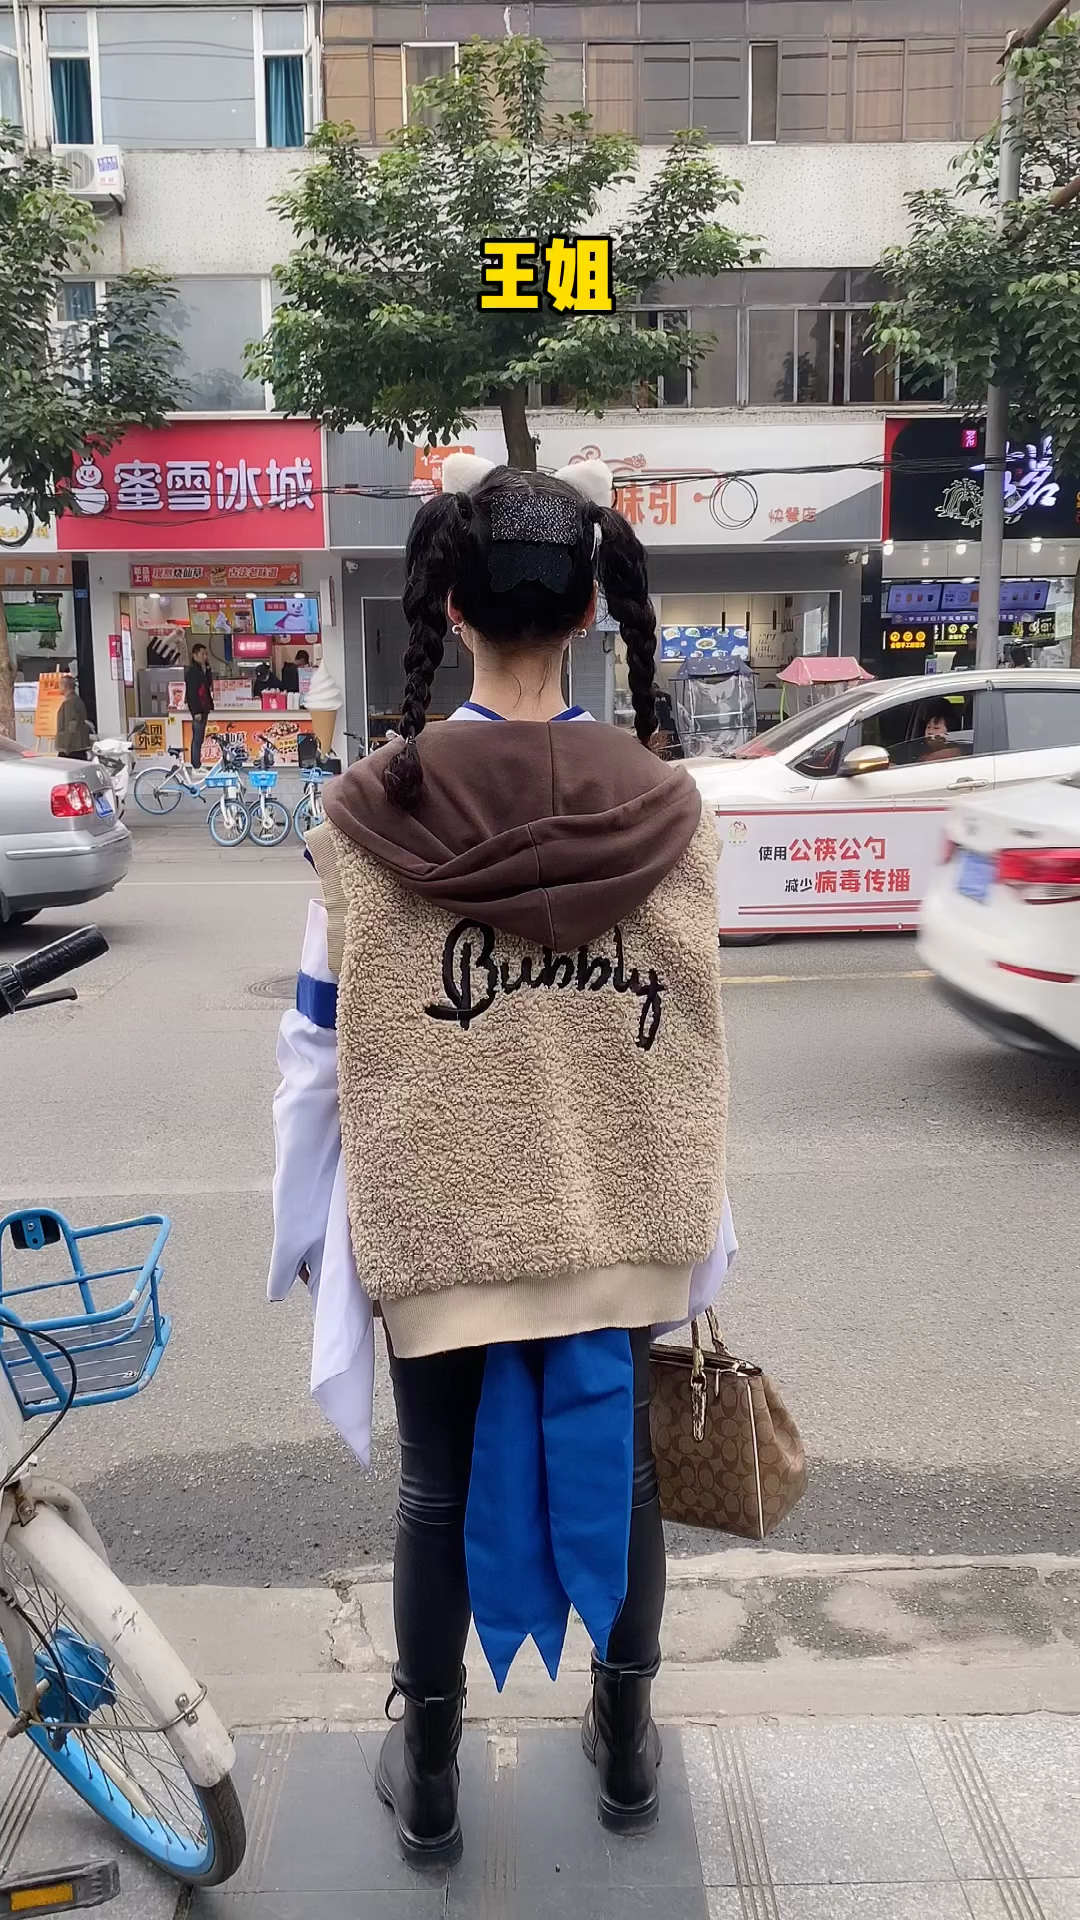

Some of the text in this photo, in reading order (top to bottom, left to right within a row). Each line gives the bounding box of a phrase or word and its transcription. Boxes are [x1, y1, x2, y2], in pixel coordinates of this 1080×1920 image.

[114, 457, 315, 511] 蜜雪冰城
[768, 506, 817, 523] 快餐店
[138, 735, 163, 750] 外卖
[758, 835, 887, 862] 使用公筷公勺
[784, 868, 911, 894] 减少病毒传播
[424, 918, 666, 1051] Bubbly
